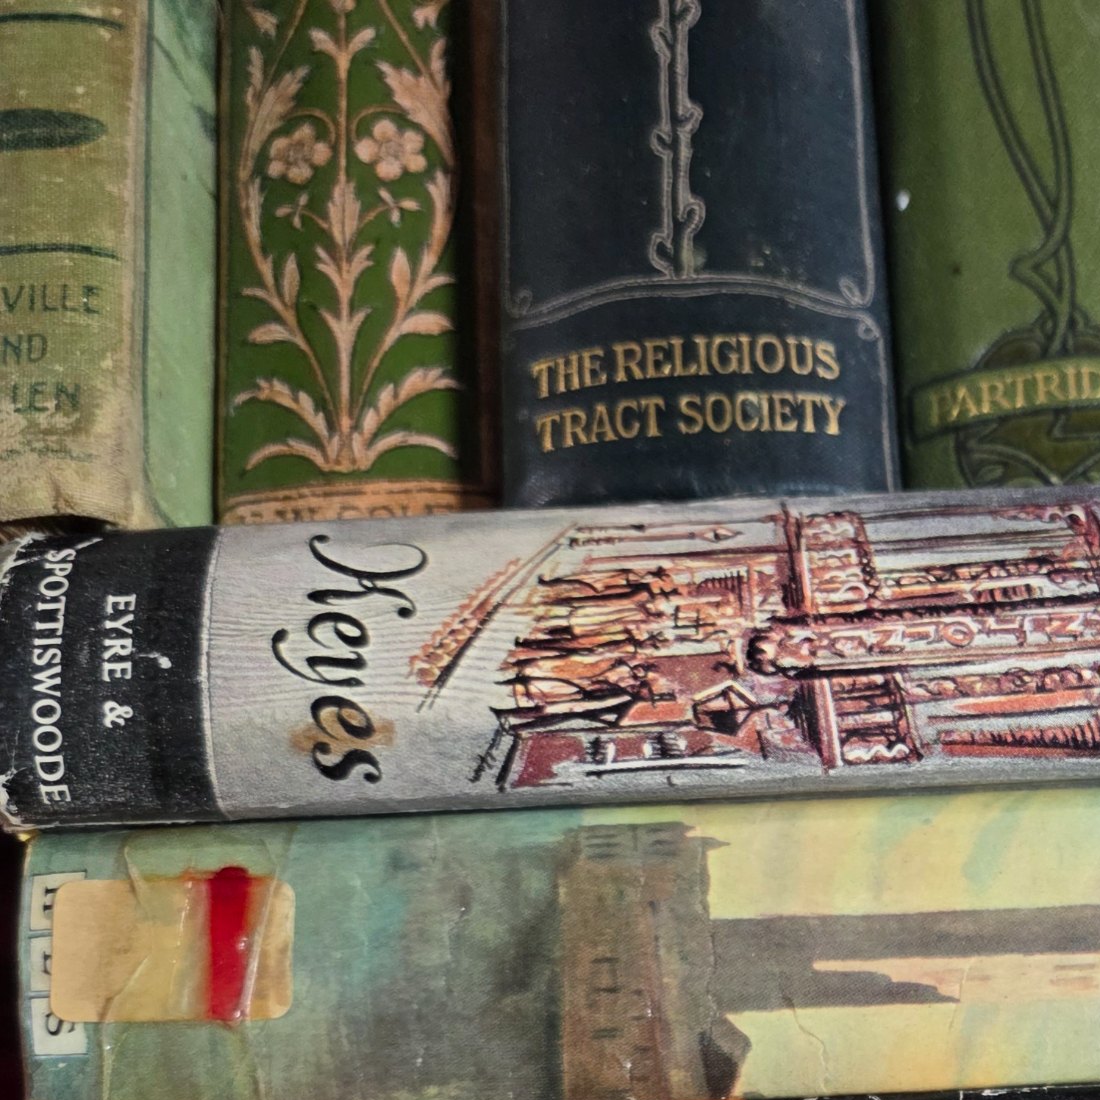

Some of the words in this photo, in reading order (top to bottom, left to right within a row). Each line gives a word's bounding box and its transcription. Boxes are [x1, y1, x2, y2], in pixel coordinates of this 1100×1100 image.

[530, 346, 608, 399] THE
[612, 333, 841, 383] RELIGIOUS
[536, 397, 666, 454] TRACT
[677, 390, 847, 436] SOCIETY
[31, 548, 76, 804] SPOTTISWOODE
[101, 594, 137, 682] EYRE
[271, 533, 430, 785] Keyes
[102, 704, 134, 728] &
